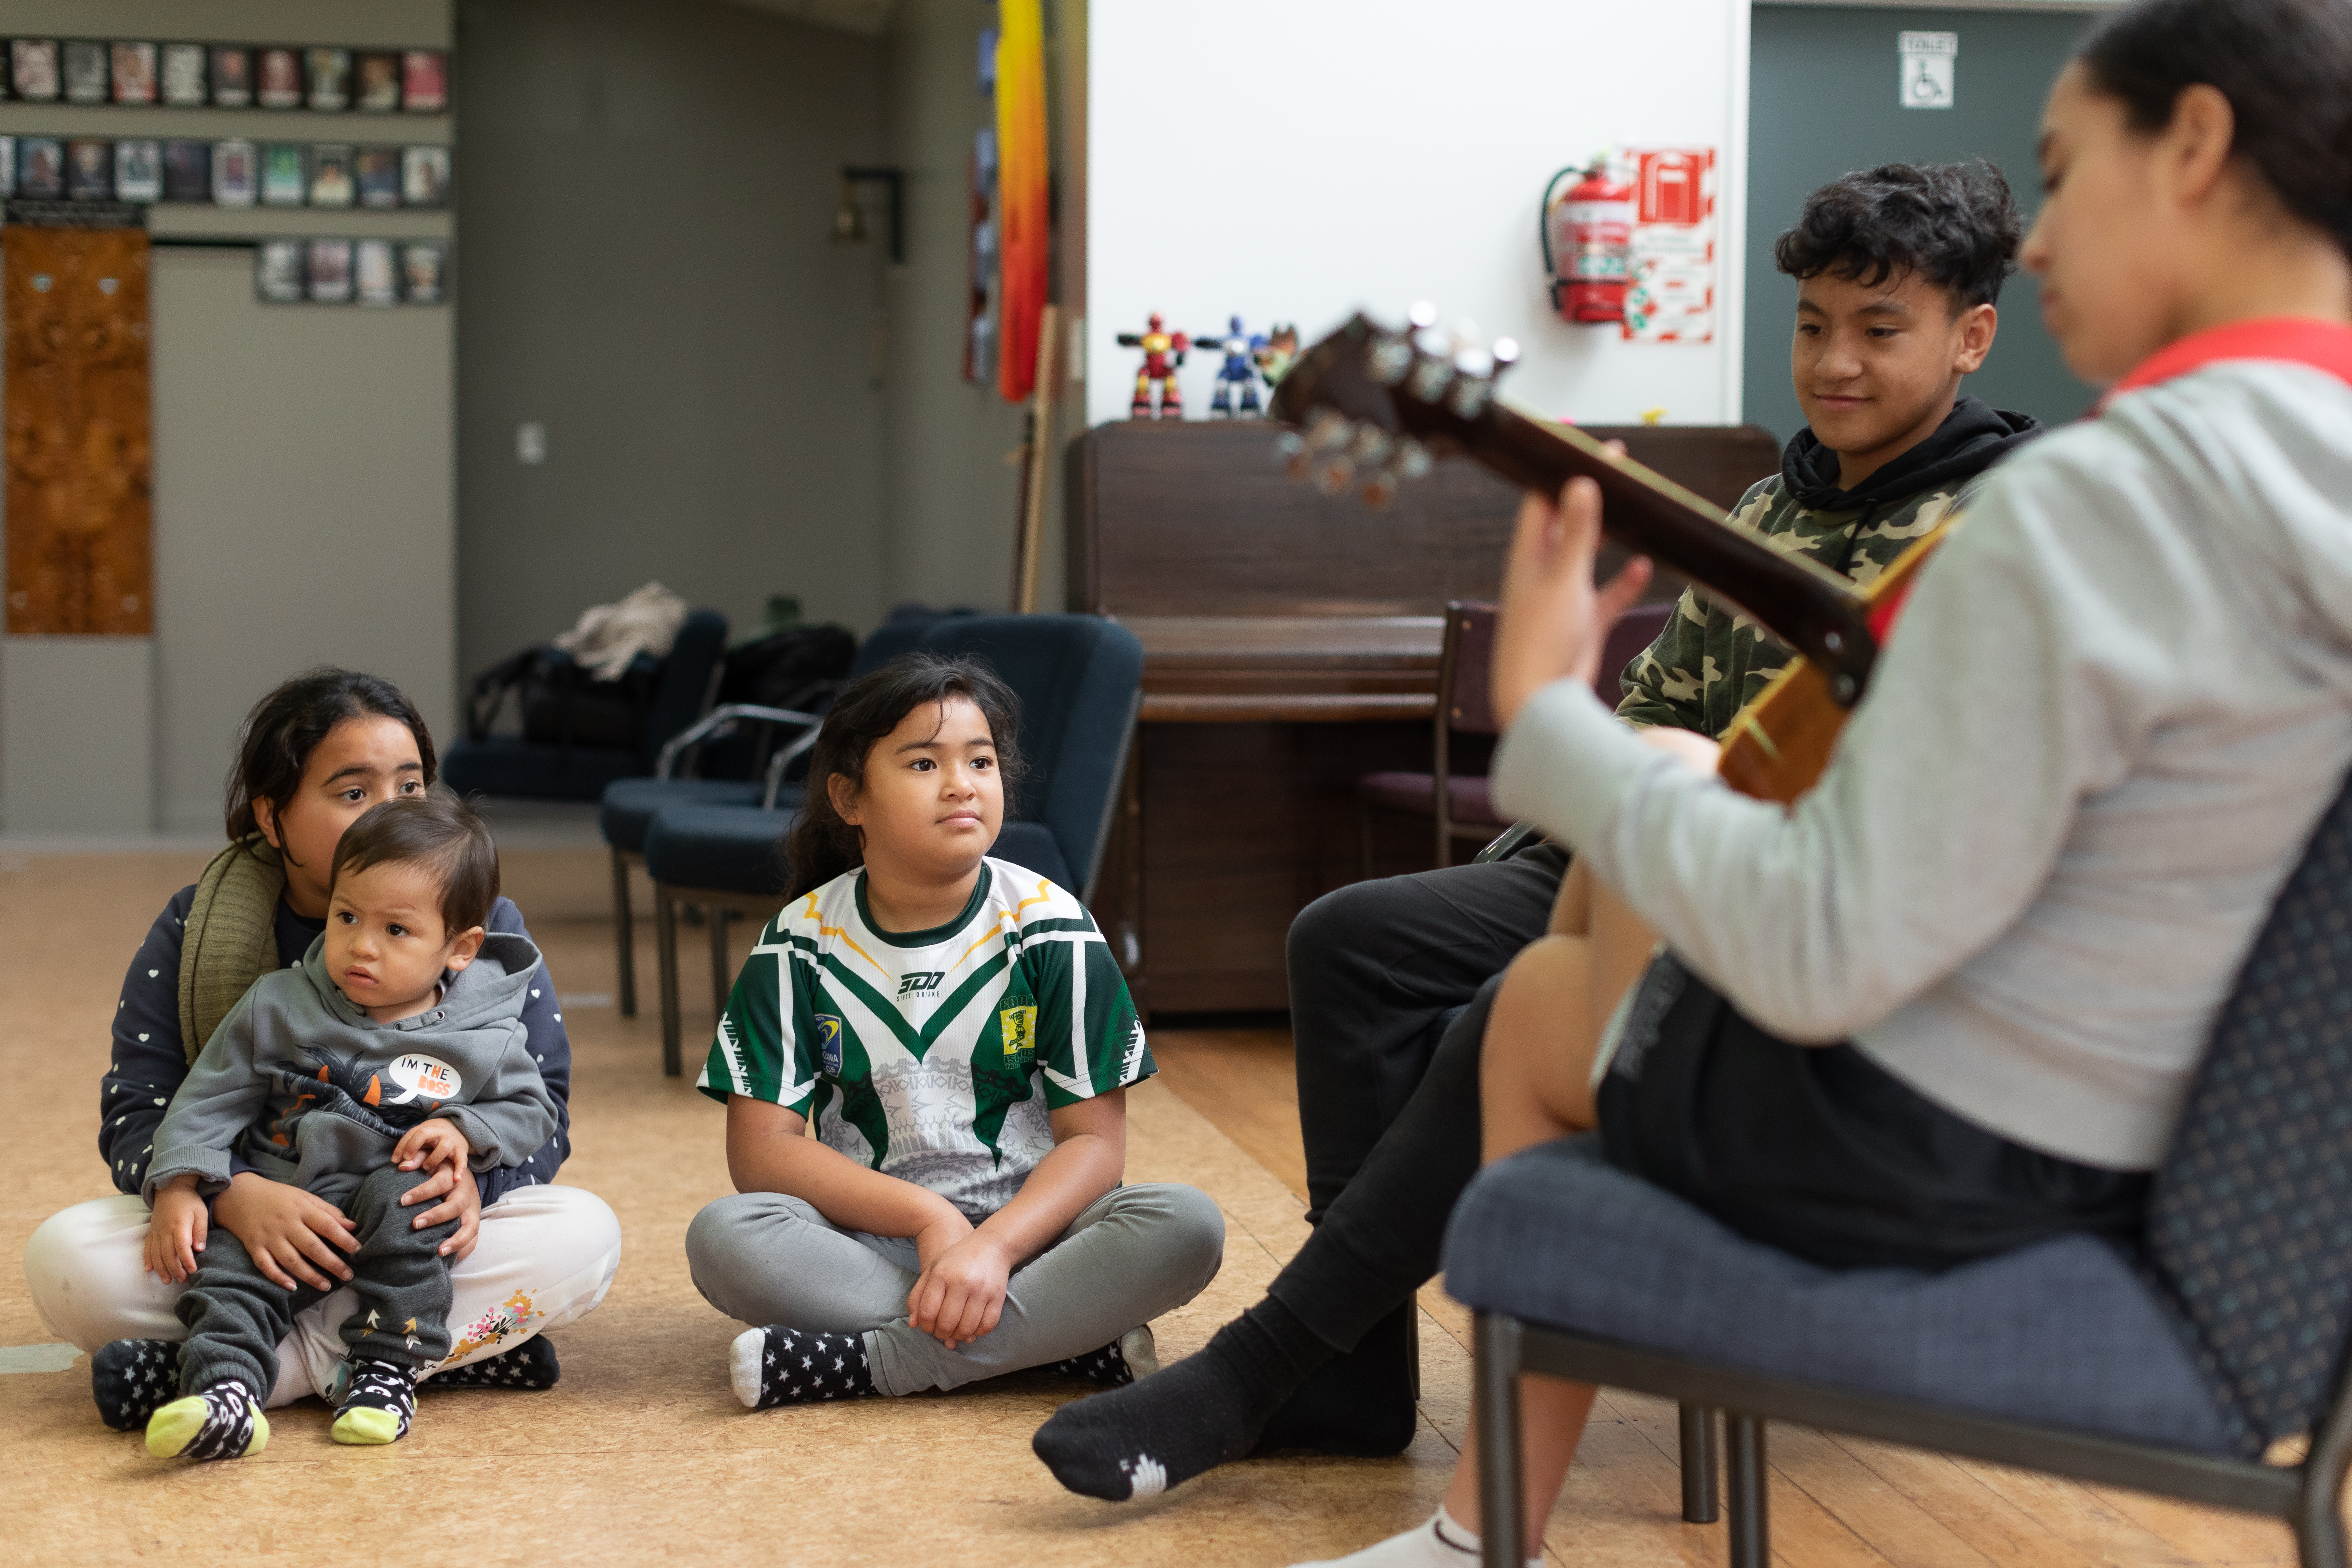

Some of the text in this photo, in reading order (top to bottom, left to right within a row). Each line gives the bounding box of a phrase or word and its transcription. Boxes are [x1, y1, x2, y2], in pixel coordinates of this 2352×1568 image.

[897, 993, 911, 1001] SINCE
[1000, 994, 1037, 1011] COOK
[822, 1050, 839, 1062] CEANIA
[402, 1056, 449, 1081] I'M THE
[826, 1065, 836, 1073] CUP
[418, 1075, 450, 1096] BOSS
